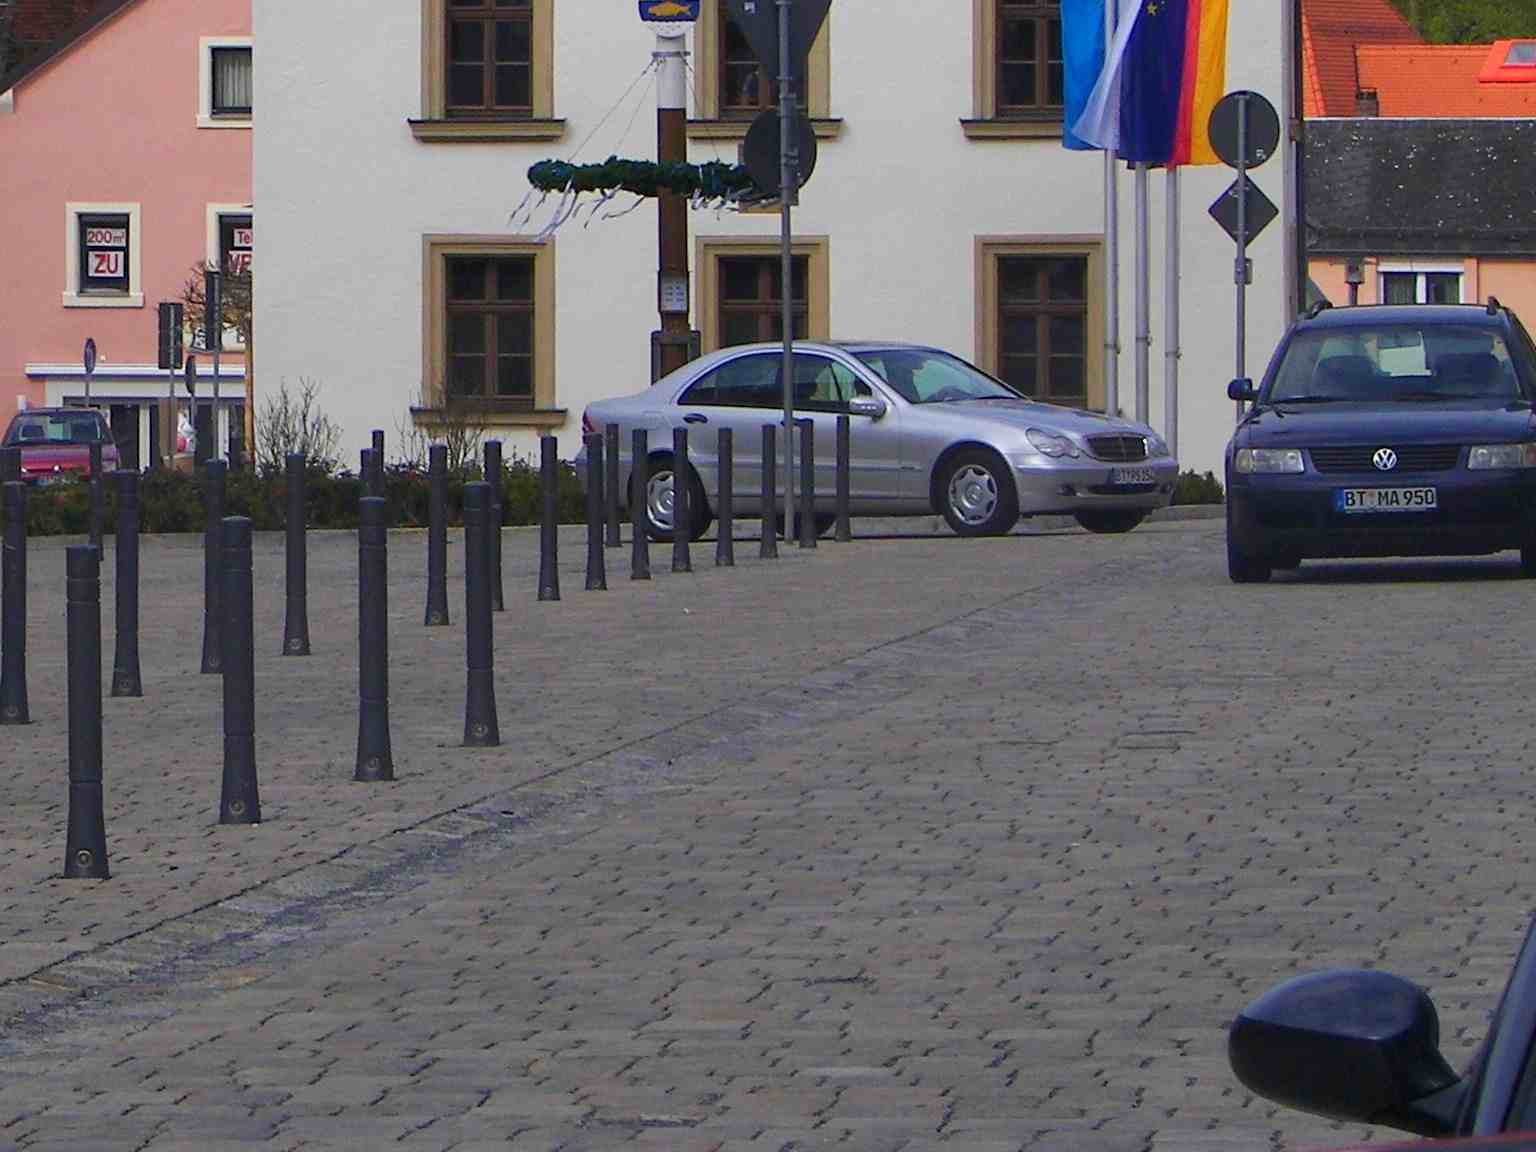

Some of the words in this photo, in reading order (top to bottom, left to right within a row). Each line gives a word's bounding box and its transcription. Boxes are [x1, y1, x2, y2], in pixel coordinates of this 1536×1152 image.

[94, 253, 119, 274] ZU
[1345, 491, 1366, 507] BT
[1377, 490, 1400, 506] MA
[1402, 489, 1434, 506] 950
